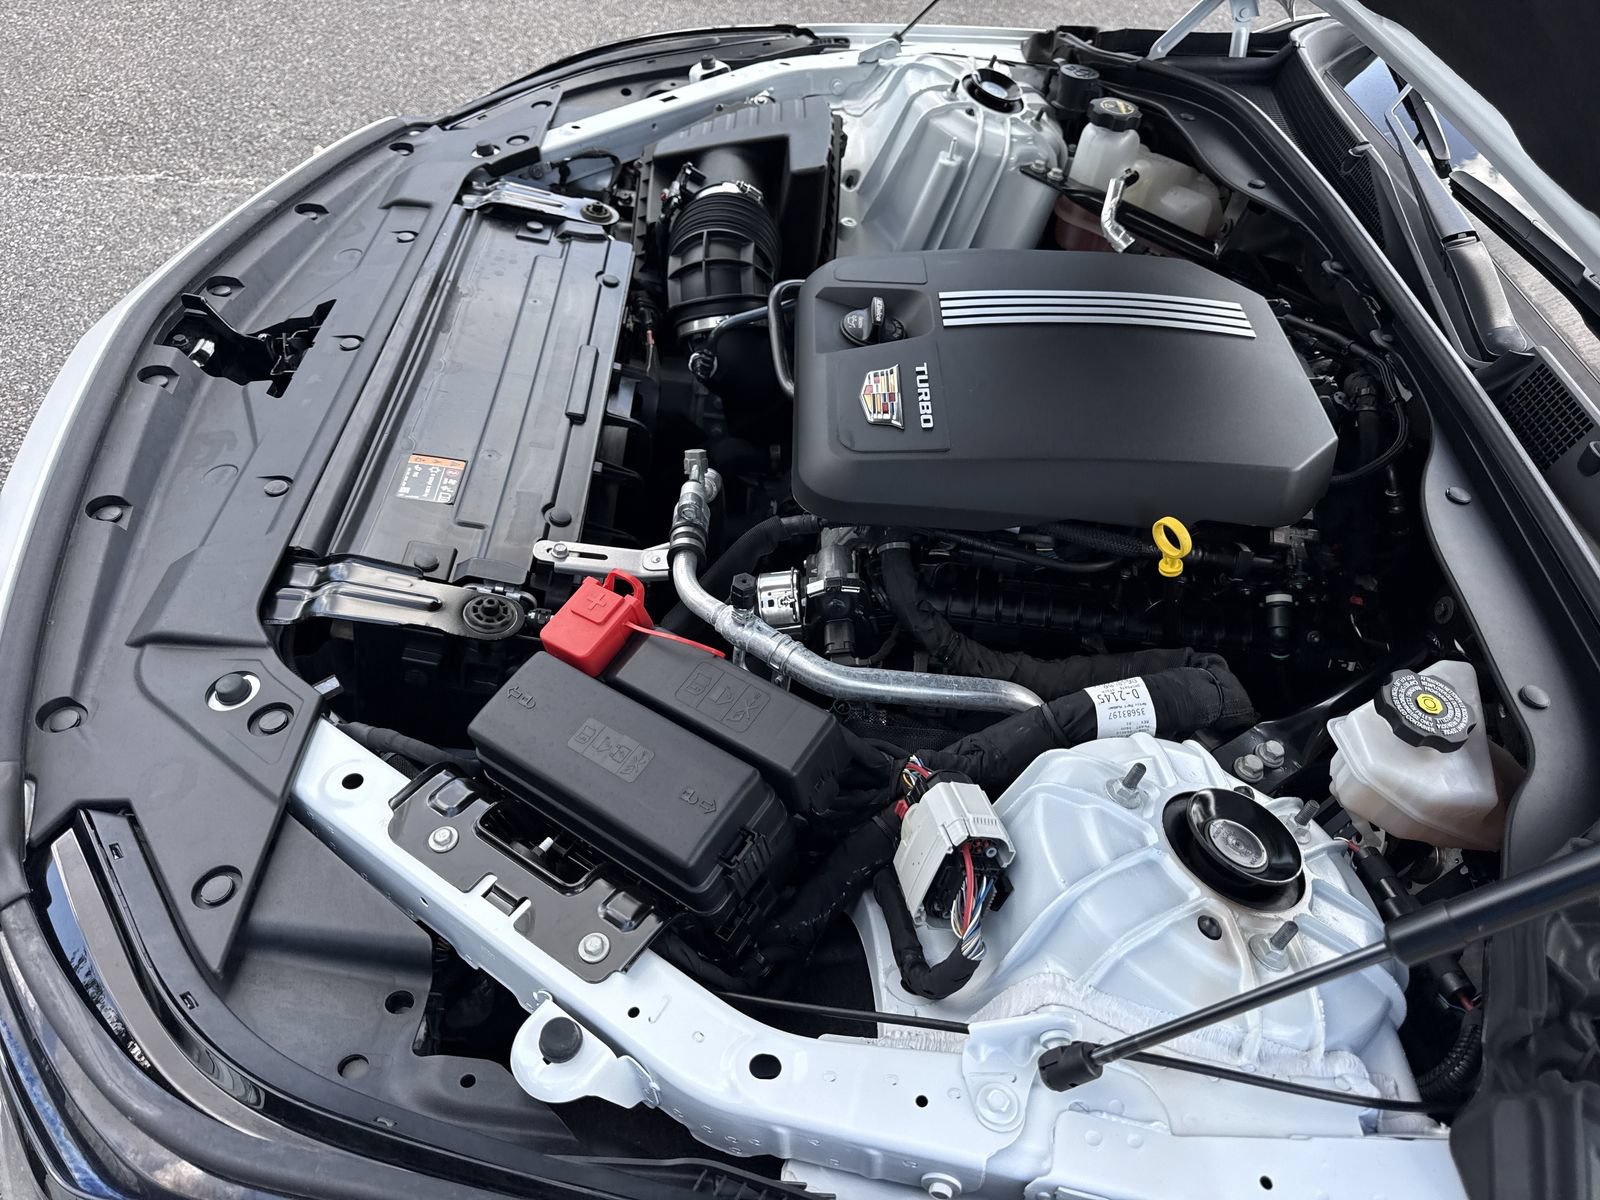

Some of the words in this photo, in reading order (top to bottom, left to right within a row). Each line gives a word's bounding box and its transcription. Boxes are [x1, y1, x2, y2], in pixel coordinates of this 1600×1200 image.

[915, 362, 933, 428] TURBO
[1097, 688, 1140, 704] D-2145
[1108, 708, 1145, 720] 35683197
